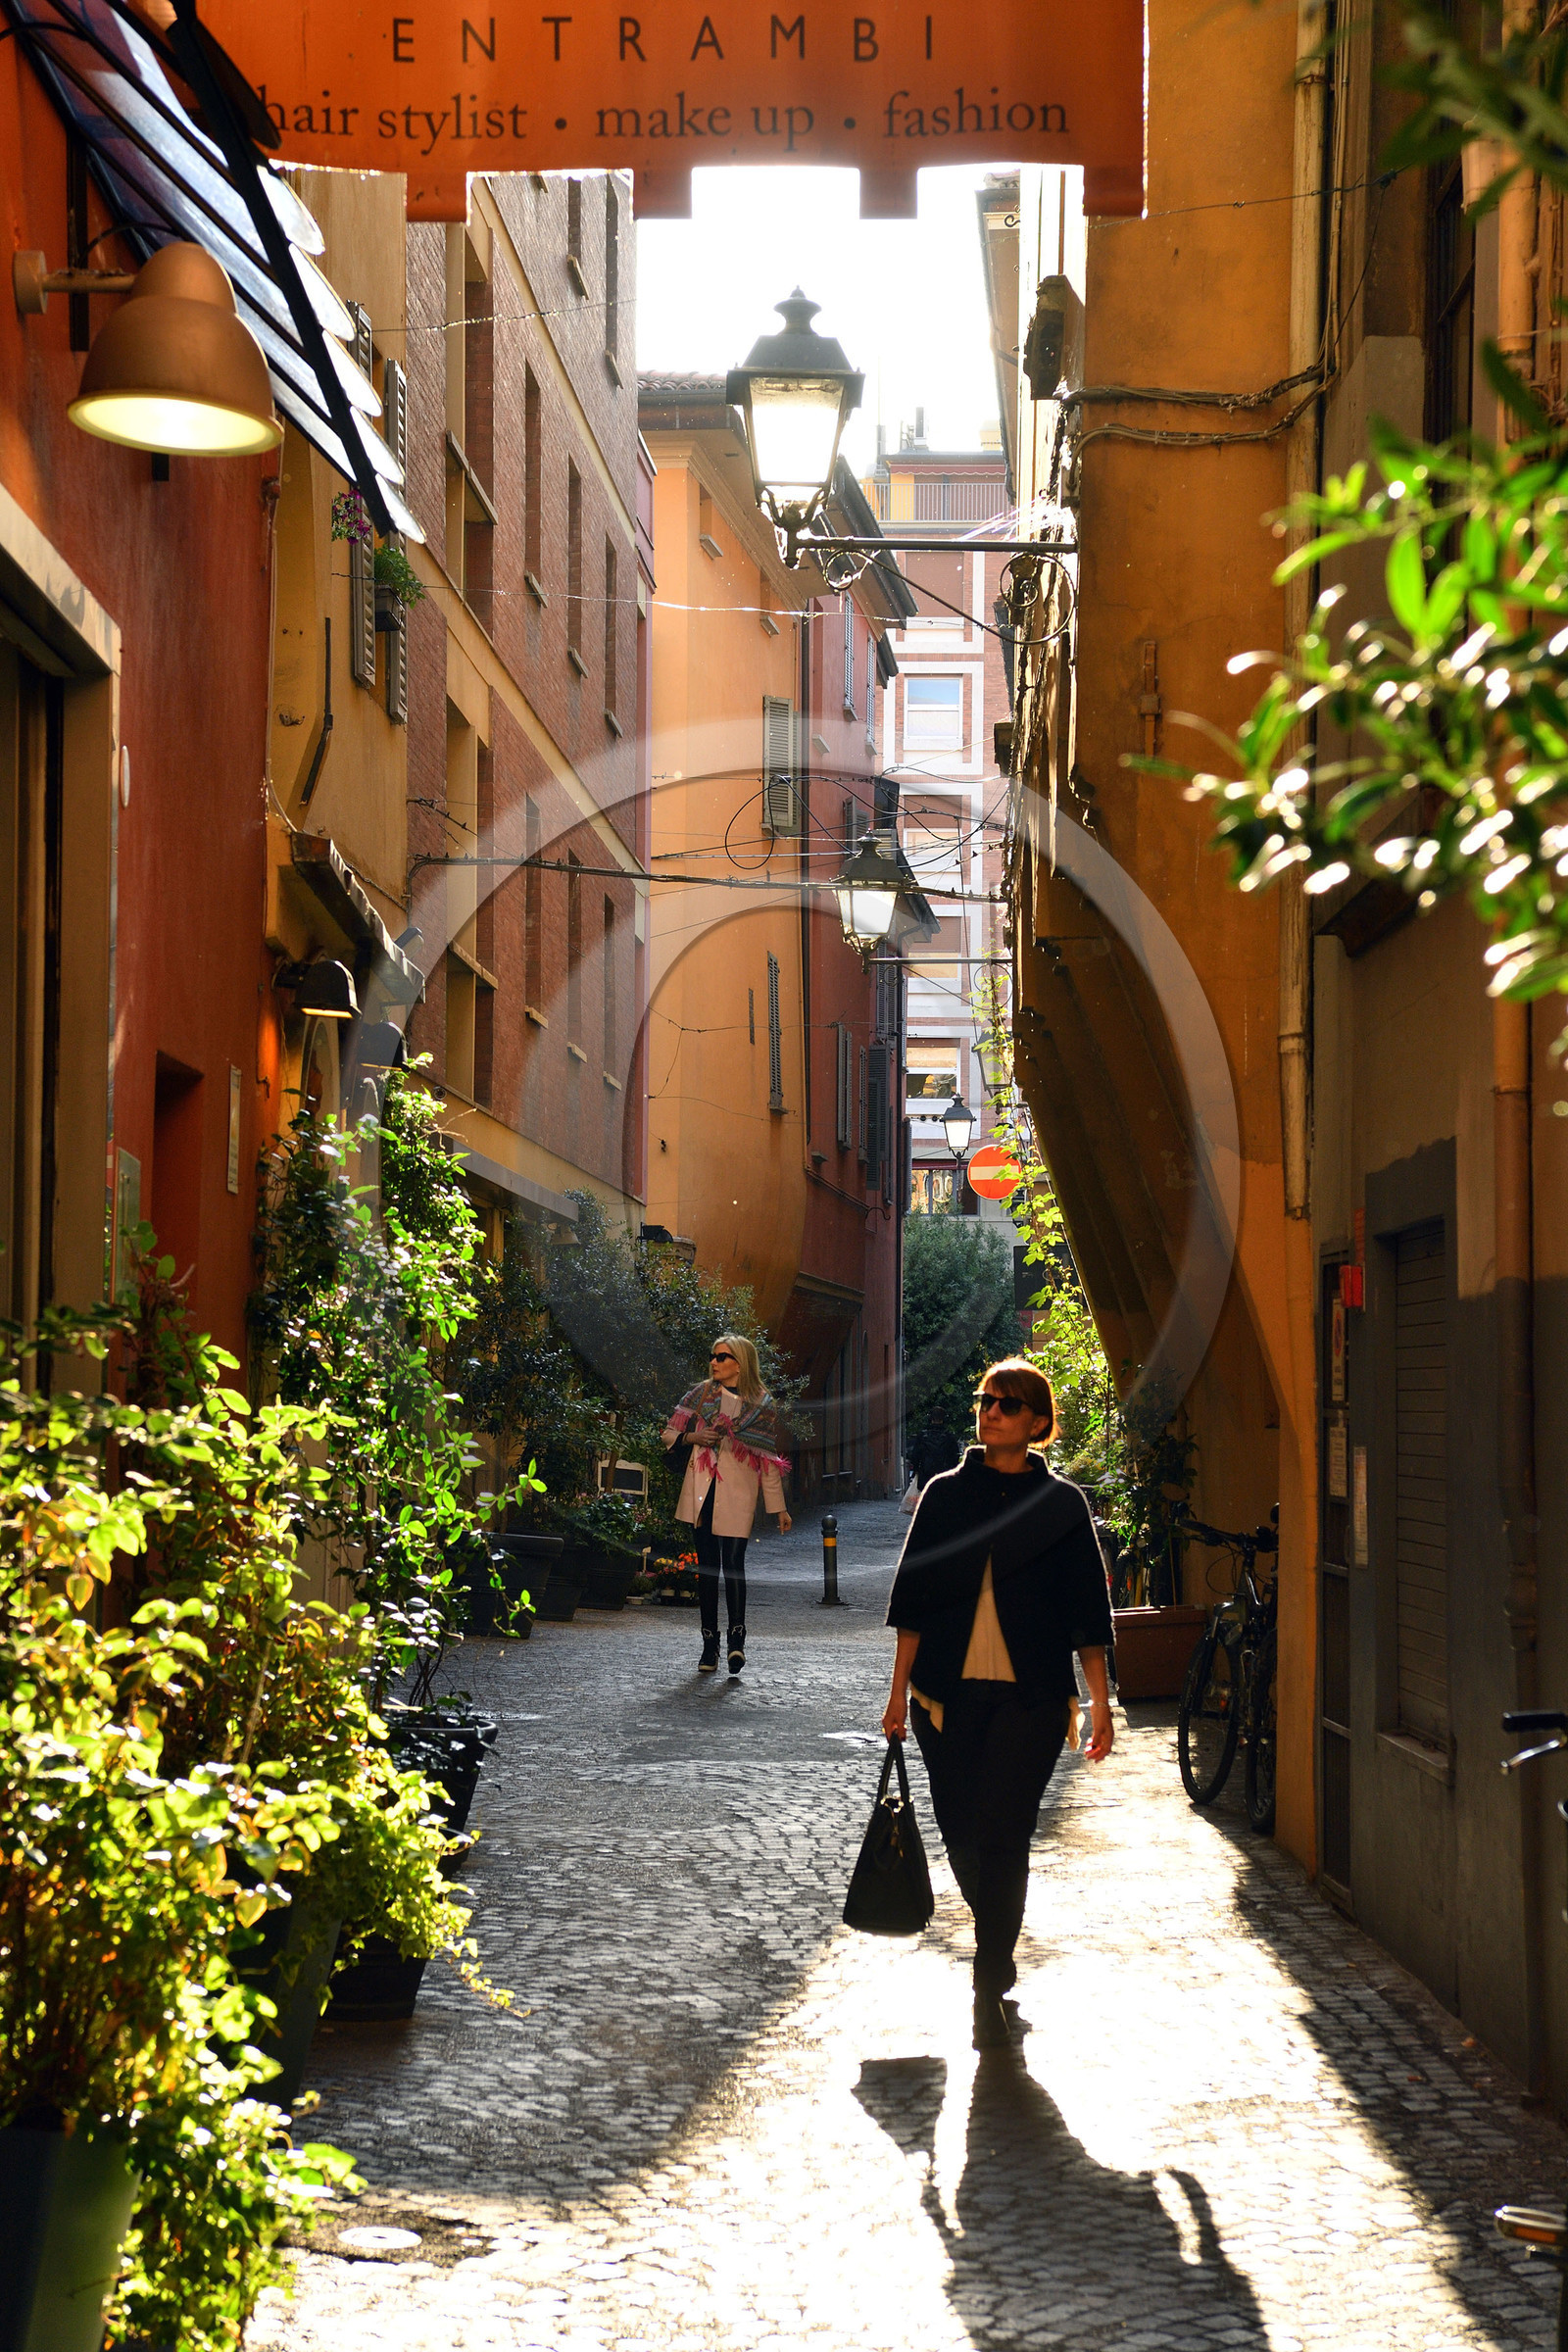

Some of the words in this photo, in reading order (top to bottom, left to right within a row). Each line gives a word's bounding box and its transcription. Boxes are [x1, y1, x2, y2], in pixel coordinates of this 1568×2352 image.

[392, 14, 933, 63] ENTRAMBI
[257, 84, 360, 136] hair
[378, 94, 527, 156] stylist
[595, 91, 732, 138] make
[751, 105, 815, 152] up
[883, 86, 1070, 138] fashion
